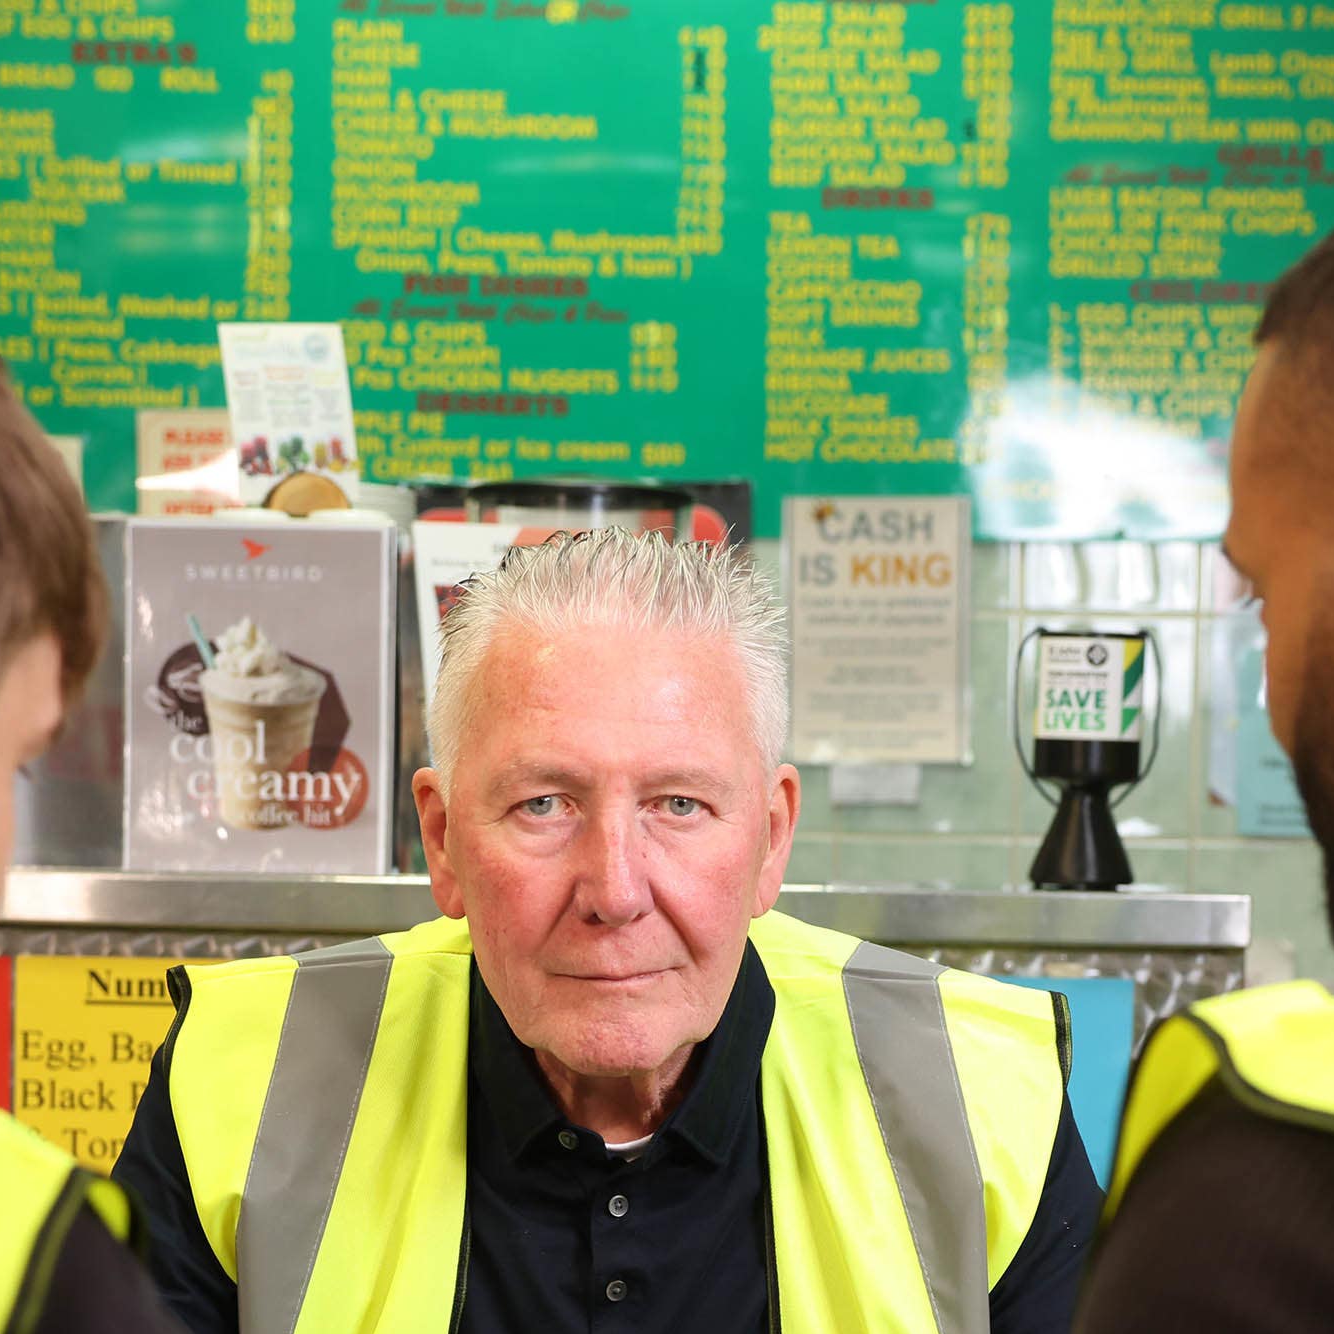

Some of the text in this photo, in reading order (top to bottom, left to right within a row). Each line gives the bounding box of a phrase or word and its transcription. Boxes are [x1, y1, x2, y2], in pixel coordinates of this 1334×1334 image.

[819, 509, 935, 544] CASH
[184, 564, 324, 582] SWEETBIRD
[799, 552, 953, 589] IS KING
[1045, 688, 1107, 711] SAVE
[1043, 710, 1106, 732] LIVES
[171, 720, 267, 764] cool
[188, 762, 363, 816] creamy
[85, 969, 167, 999] Num
[20, 1029, 153, 1071] Egg, Ba
[21, 1079, 117, 1111] Black
